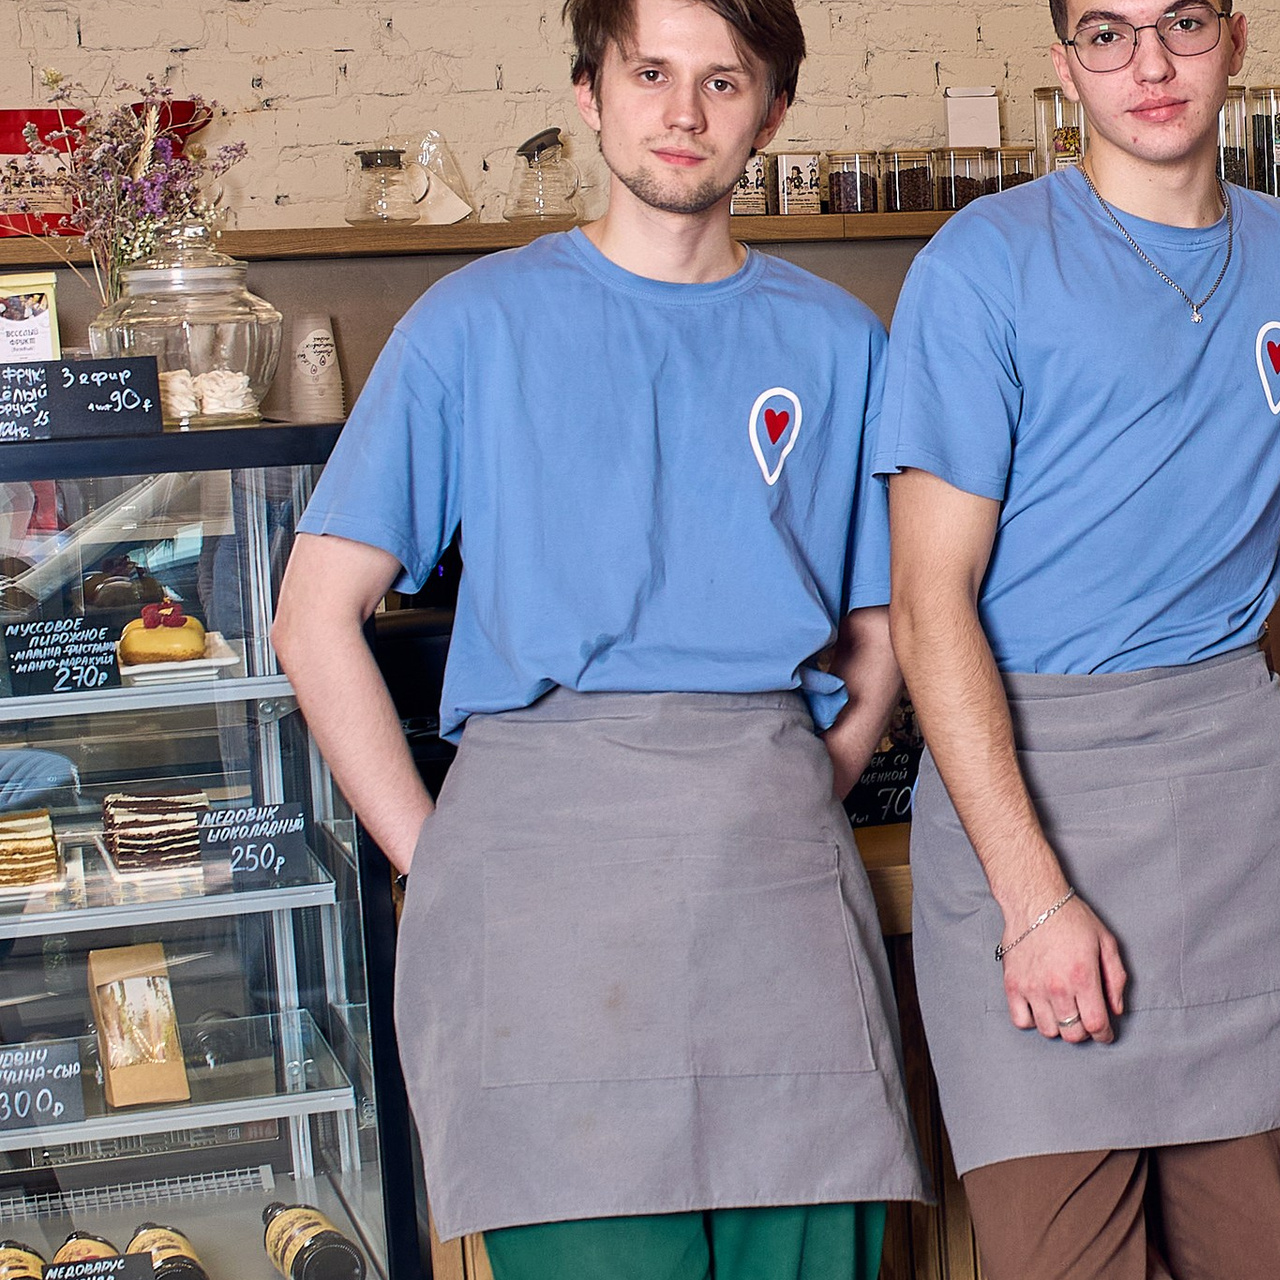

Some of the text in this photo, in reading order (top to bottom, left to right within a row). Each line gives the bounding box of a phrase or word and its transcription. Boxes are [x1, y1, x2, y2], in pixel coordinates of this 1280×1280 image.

[5, 618, 84, 637] МУССОВОЕ
[29, 627, 108, 648] ПИРОЖНОЕ
[201, 805, 280, 828] МЕДОВИК
[207, 813, 304, 843] ШОКОЛАДНЫЙ
[0, 1061, 81, 1085] ЧИНА-СЫР
[45, 1258, 125, 1280] МЕДОВАРУС
